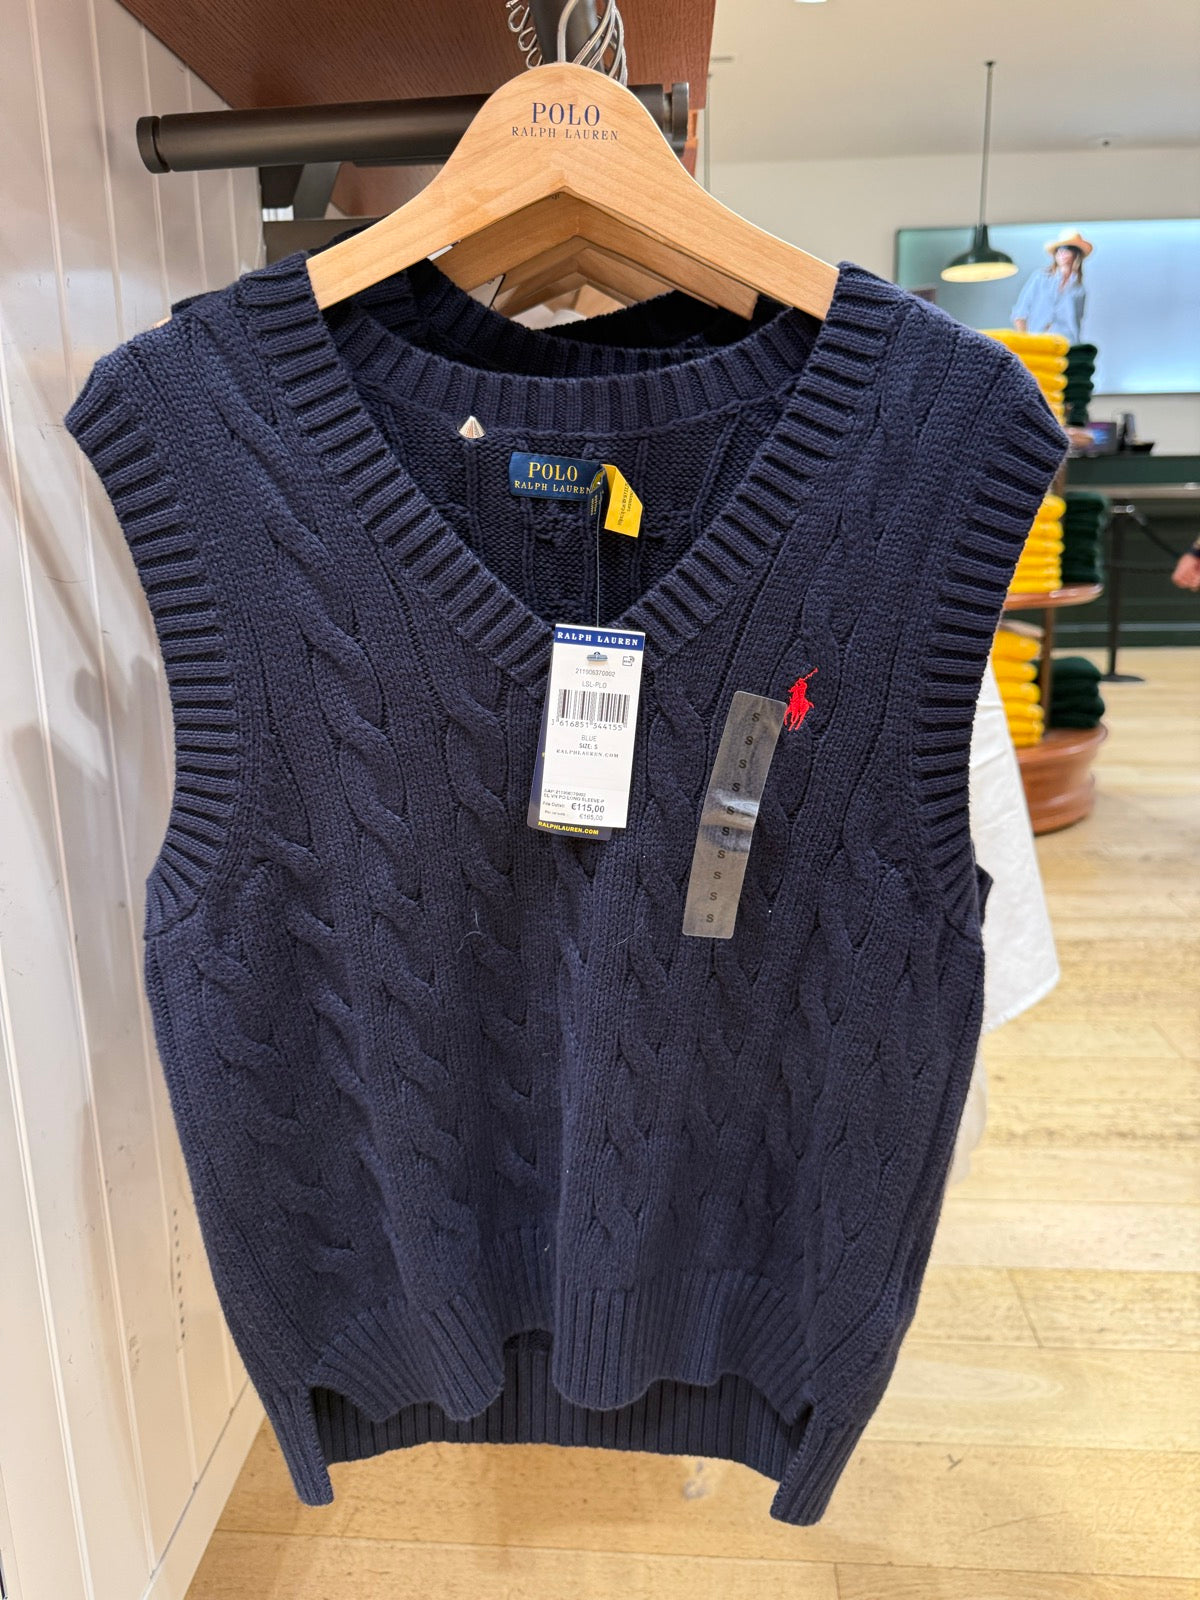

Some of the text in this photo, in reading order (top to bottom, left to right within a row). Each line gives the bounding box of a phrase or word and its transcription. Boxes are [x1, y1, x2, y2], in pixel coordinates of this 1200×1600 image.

[531, 102, 601, 126] POLO
[512, 126, 618, 140] RALPH LAUREN
[528, 461, 578, 482] POLO
[514, 480, 591, 495] RALPH LAUREN
[557, 631, 638, 646] RALPH LAUREN
[752, 712, 761, 722] S
[581, 734, 597, 742] BLUE
[744, 735, 754, 746] S
[556, 749, 619, 758] RALPHLAUREN.COM
[738, 759, 747, 769] S
[731, 782, 741, 792] S
[571, 802, 605, 813] €115,00
[726, 805, 735, 815] S
[538, 821, 599, 835] RALPHLAUREN.COM
[721, 826, 730, 836] S
[717, 849, 726, 859] S
[713, 871, 722, 880] S
[709, 891, 718, 901] S
[706, 913, 714, 923] S
